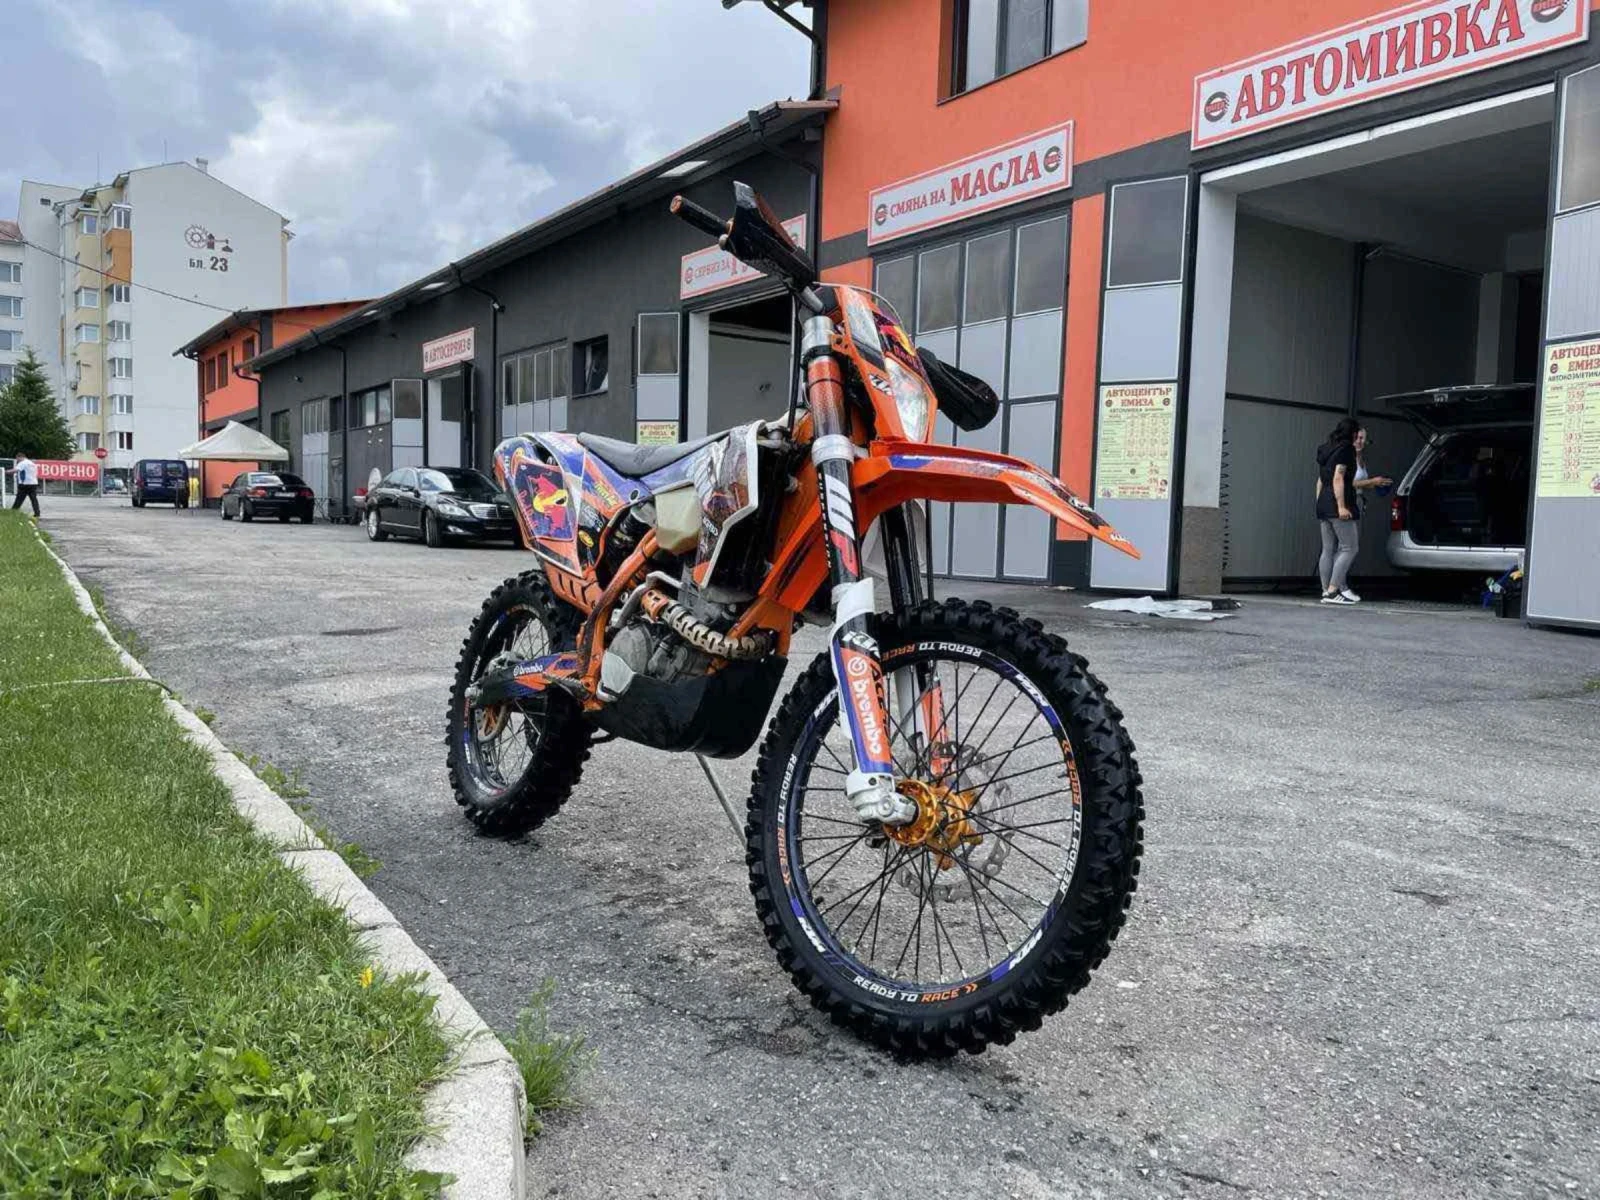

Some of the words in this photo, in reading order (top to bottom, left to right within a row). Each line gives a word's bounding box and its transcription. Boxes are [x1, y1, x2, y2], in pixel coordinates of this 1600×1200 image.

[1230, 0, 1526, 125] АВТОМИВКА
[889, 194, 928, 218] СМЯНА
[929, 189, 946, 206] НА
[950, 150, 1043, 206] МАСЛА
[209, 256, 229, 272] 23
[1550, 343, 1600, 360] АВТОЦЕ
[1105, 387, 1173, 398] АВТОЦЕНТЪР
[918, 642, 937, 651] TO
[938, 642, 983, 658] READY
[851, 679, 883, 755] brembo
[779, 753, 798, 802] READY
[777, 801, 788, 824] TO
[1060, 838, 1079, 895] READY
[1073, 810, 1081, 833] TO
[852, 974, 898, 999] READY
[899, 991, 918, 1003] TO
[920, 988, 960, 1003] RACE
